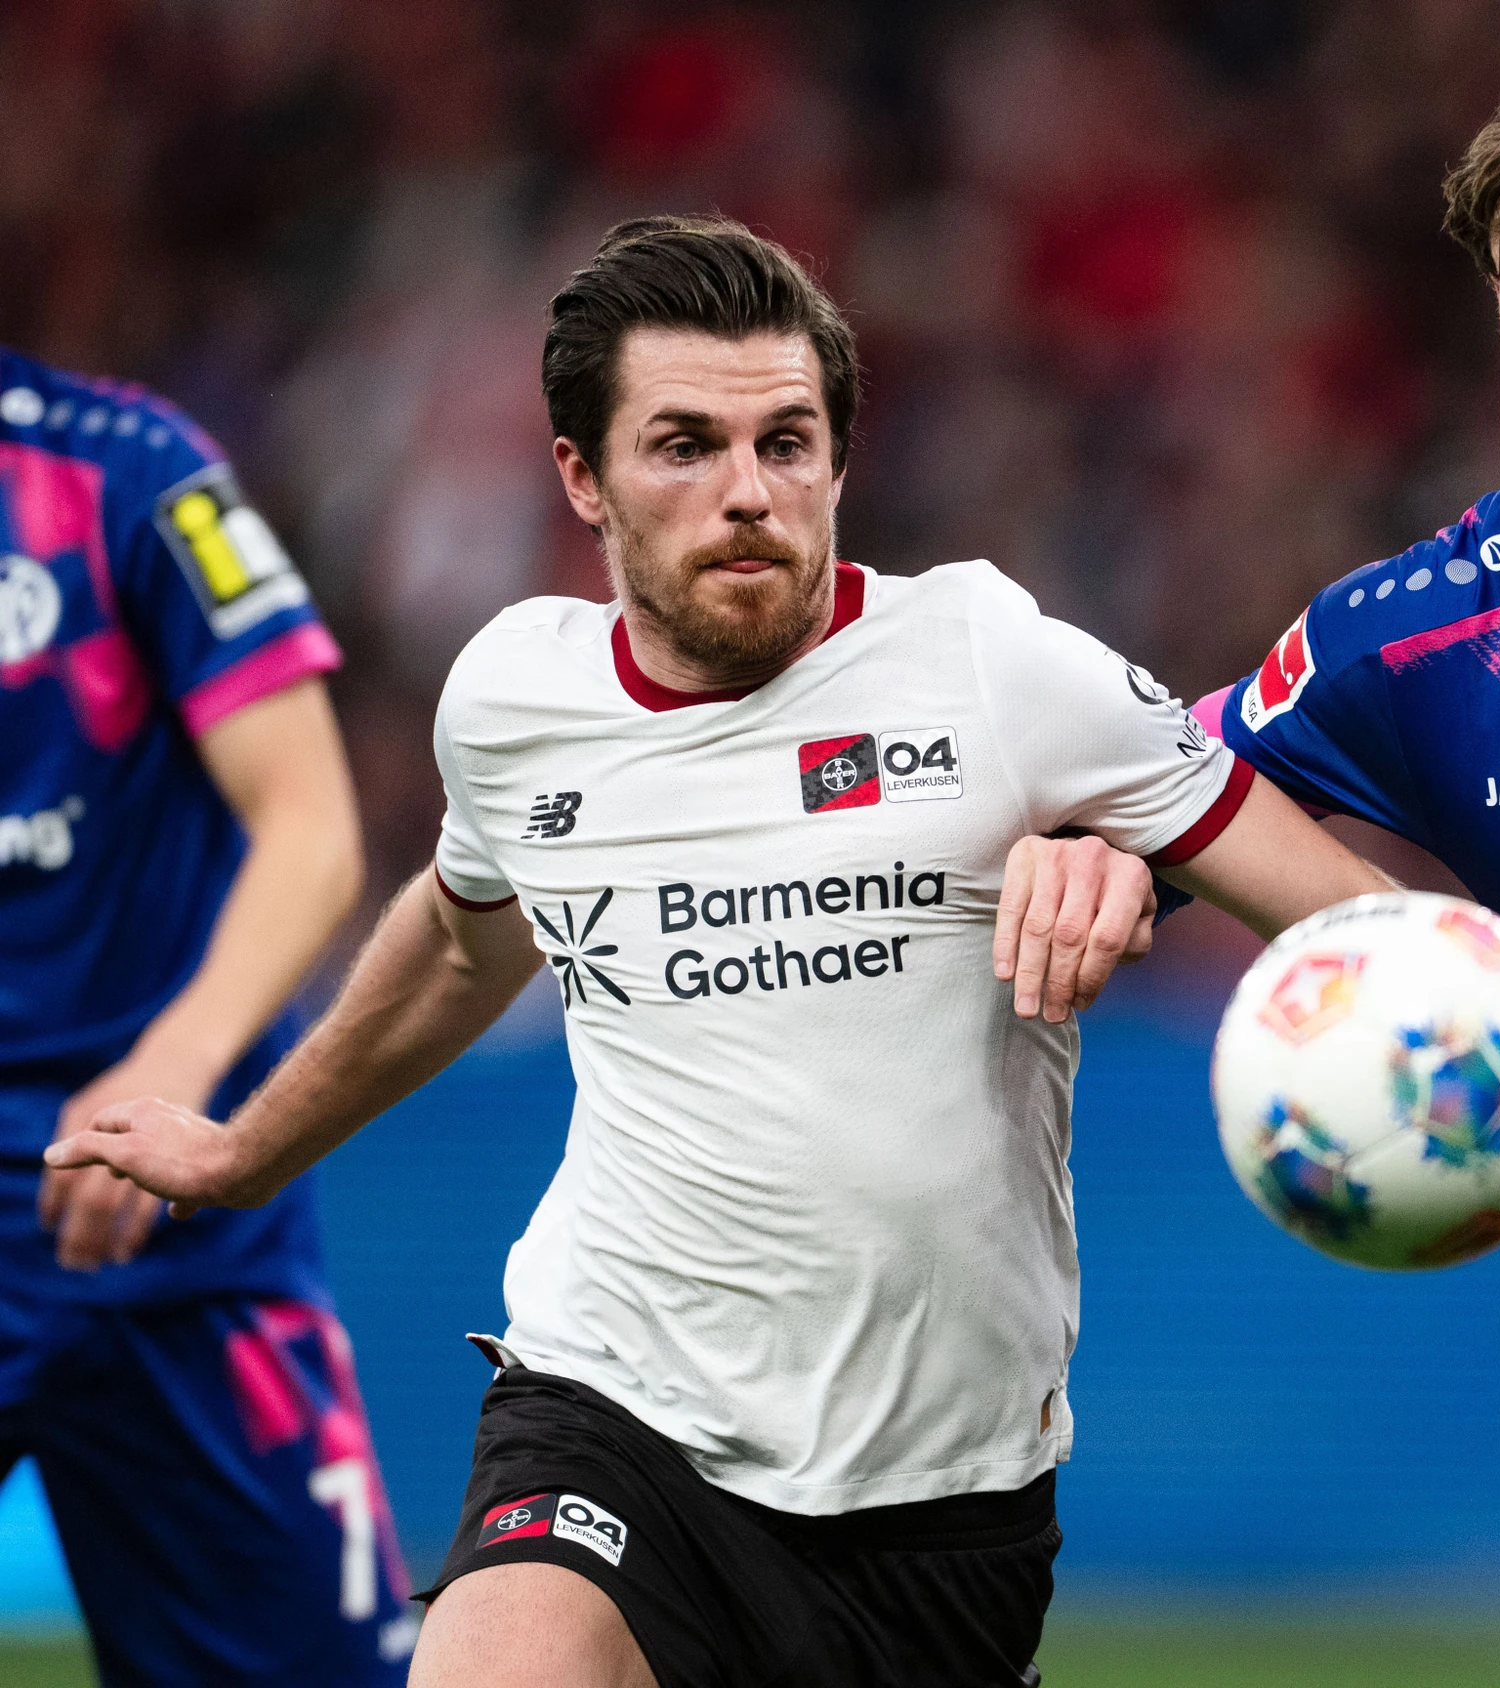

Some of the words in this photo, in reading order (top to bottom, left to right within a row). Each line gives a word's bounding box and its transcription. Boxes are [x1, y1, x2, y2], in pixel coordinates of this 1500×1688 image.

[883, 736, 957, 776] 04
[887, 775, 959, 791] LEVERKUSEN
[658, 861, 946, 934] Barmenia
[665, 934, 910, 1000] Gothaer
[556, 1523, 620, 1559] LEVERKUSEN
[559, 1503, 623, 1548] 04
